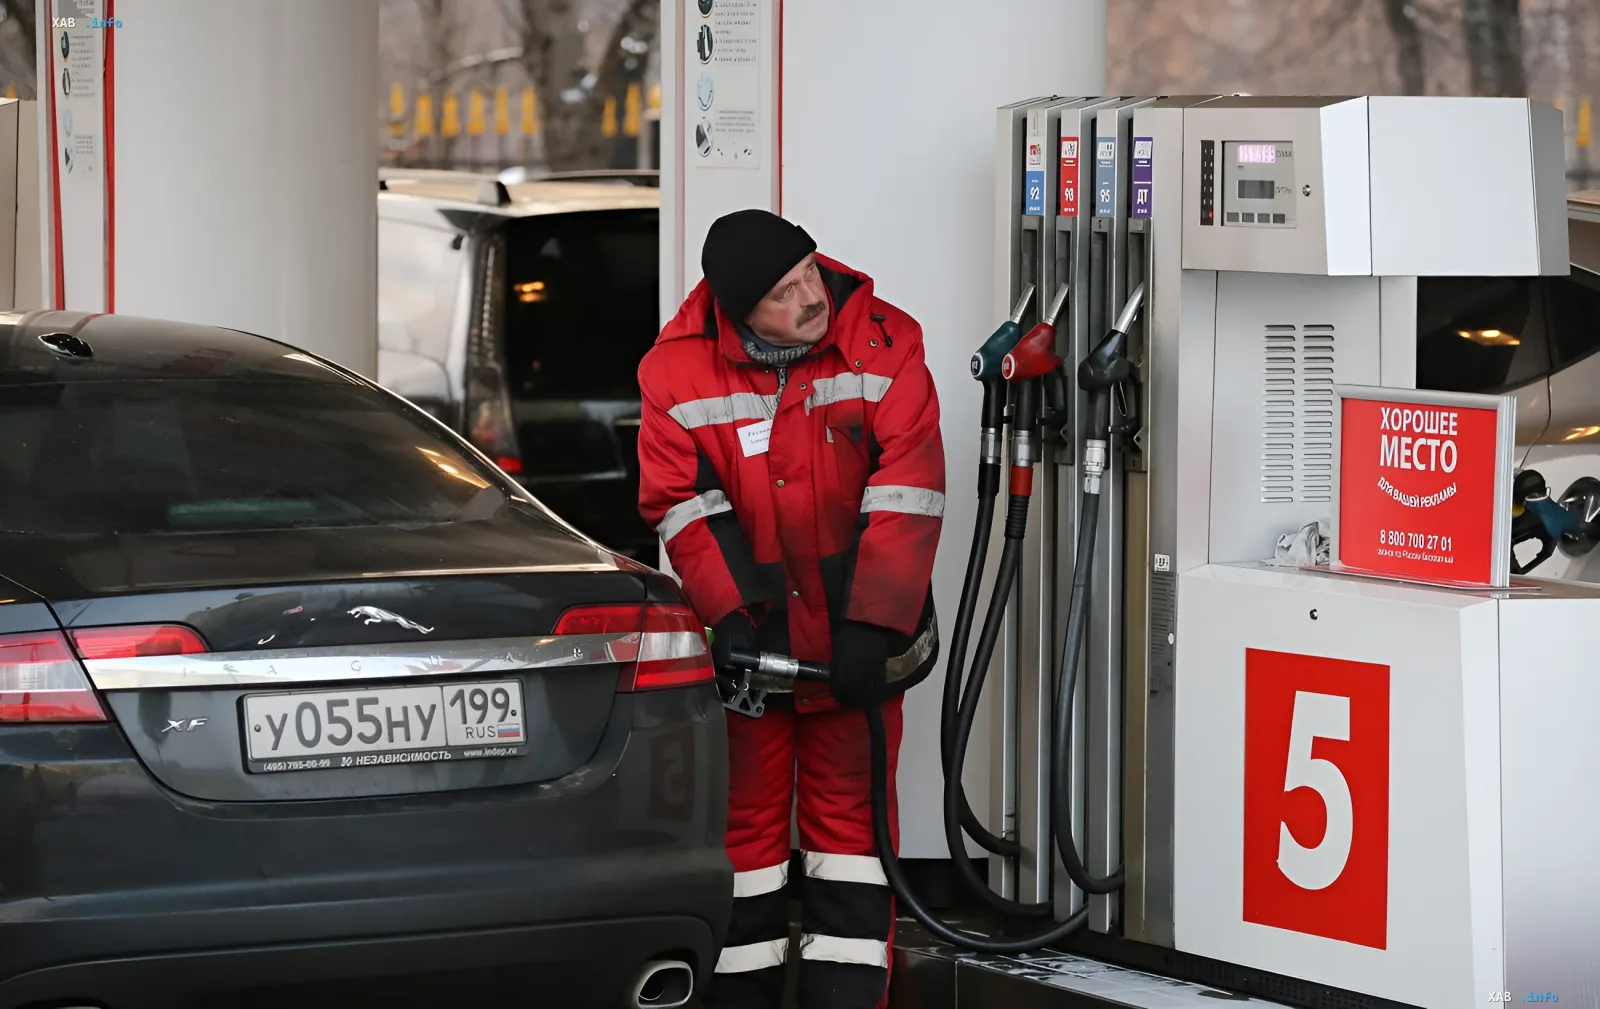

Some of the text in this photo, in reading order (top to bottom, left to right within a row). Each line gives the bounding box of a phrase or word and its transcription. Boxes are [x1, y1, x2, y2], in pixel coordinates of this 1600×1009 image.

[1380, 407, 1458, 436] ХОРОШЕЕ
[1379, 434, 1458, 473] МЕСТО
[1380, 529, 1452, 552] 8 800 700 27 01
[449, 687, 511, 725] 199
[161, 717, 208, 733] XF
[465, 725, 496, 739] RUS
[355, 750, 452, 766] НЕЗАВИСИМОСТЬ
[1276, 690, 1354, 891] 5
